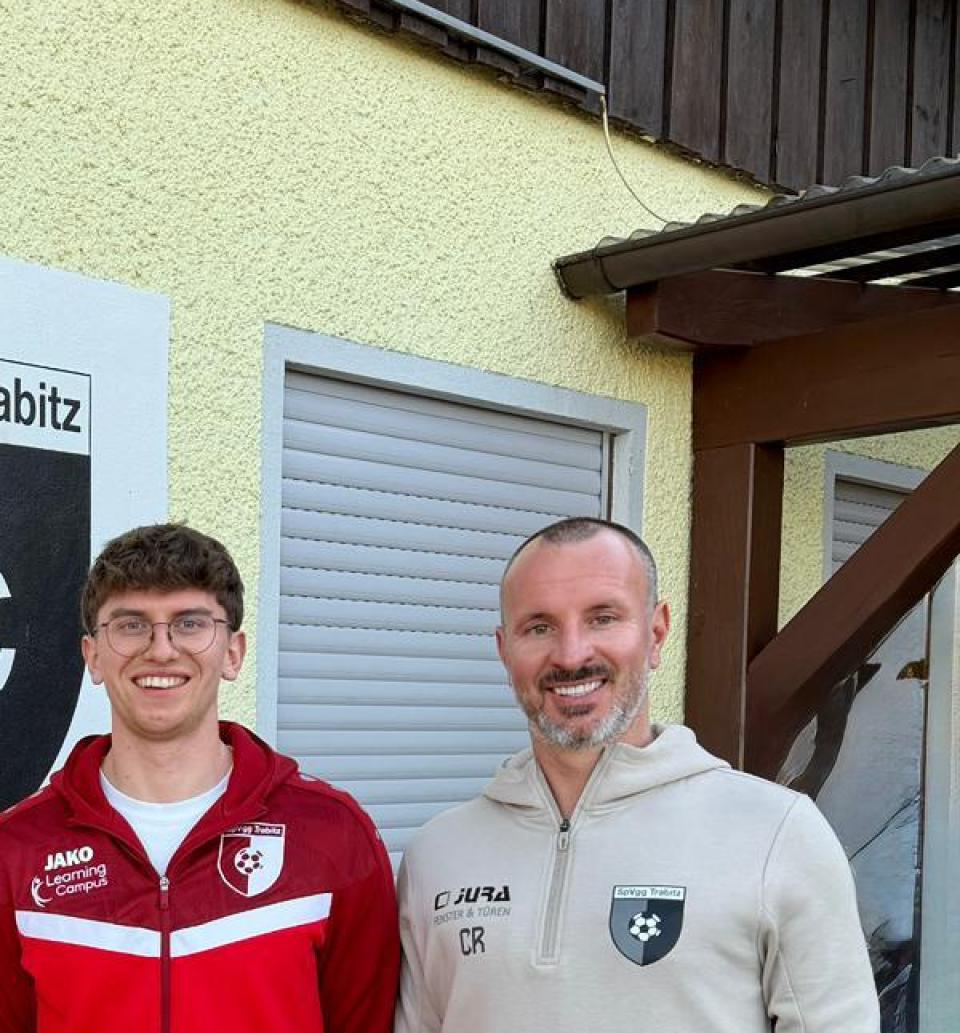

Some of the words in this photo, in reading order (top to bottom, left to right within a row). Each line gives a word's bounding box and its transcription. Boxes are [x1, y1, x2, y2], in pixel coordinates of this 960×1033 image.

[44, 846, 94, 872] JAKO
[46, 863, 107, 888] Learning
[55, 876, 108, 896] Campus
[459, 926, 486, 956] CR
